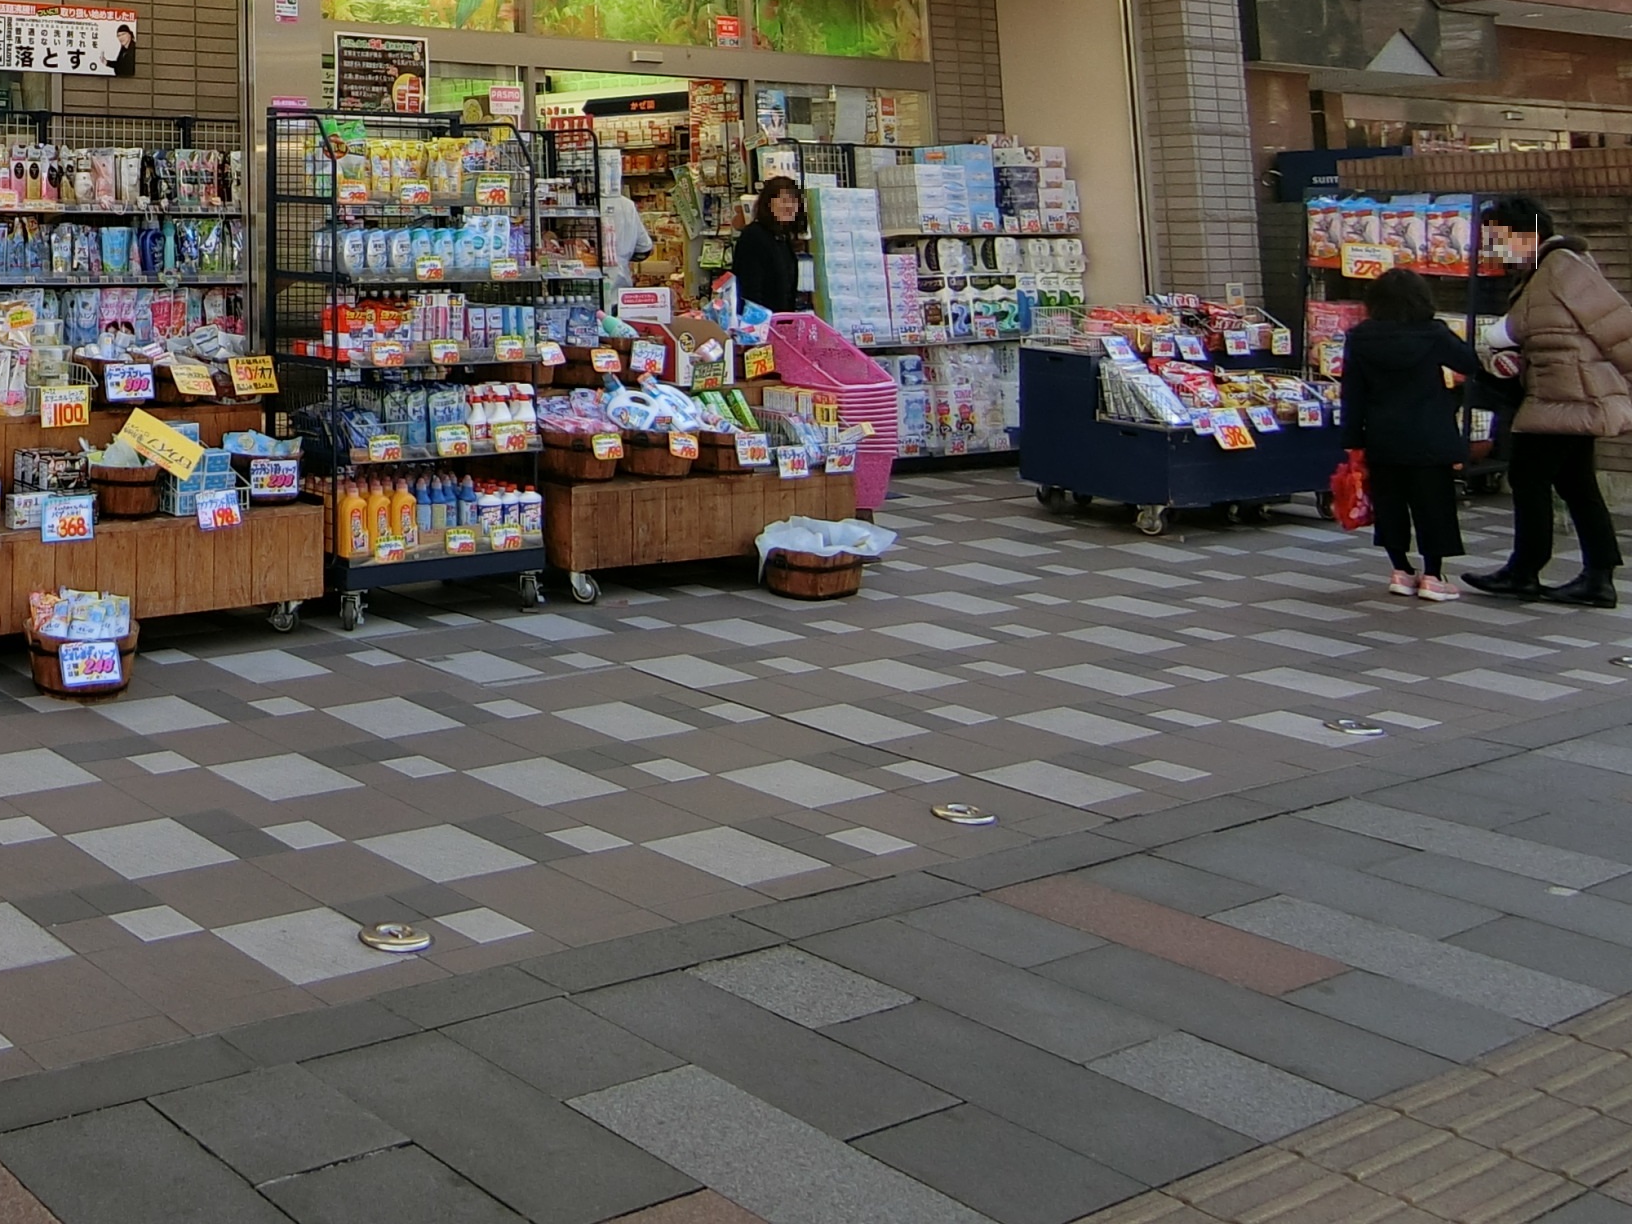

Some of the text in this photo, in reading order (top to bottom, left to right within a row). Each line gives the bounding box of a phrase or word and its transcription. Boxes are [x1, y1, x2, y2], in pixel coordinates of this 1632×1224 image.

[15, 46, 98, 71] 落とす。
[1353, 260, 1383, 276] 278
[752, 359, 768, 376] 78
[53, 403, 84, 426] 1100
[58, 517, 88, 538] 368
